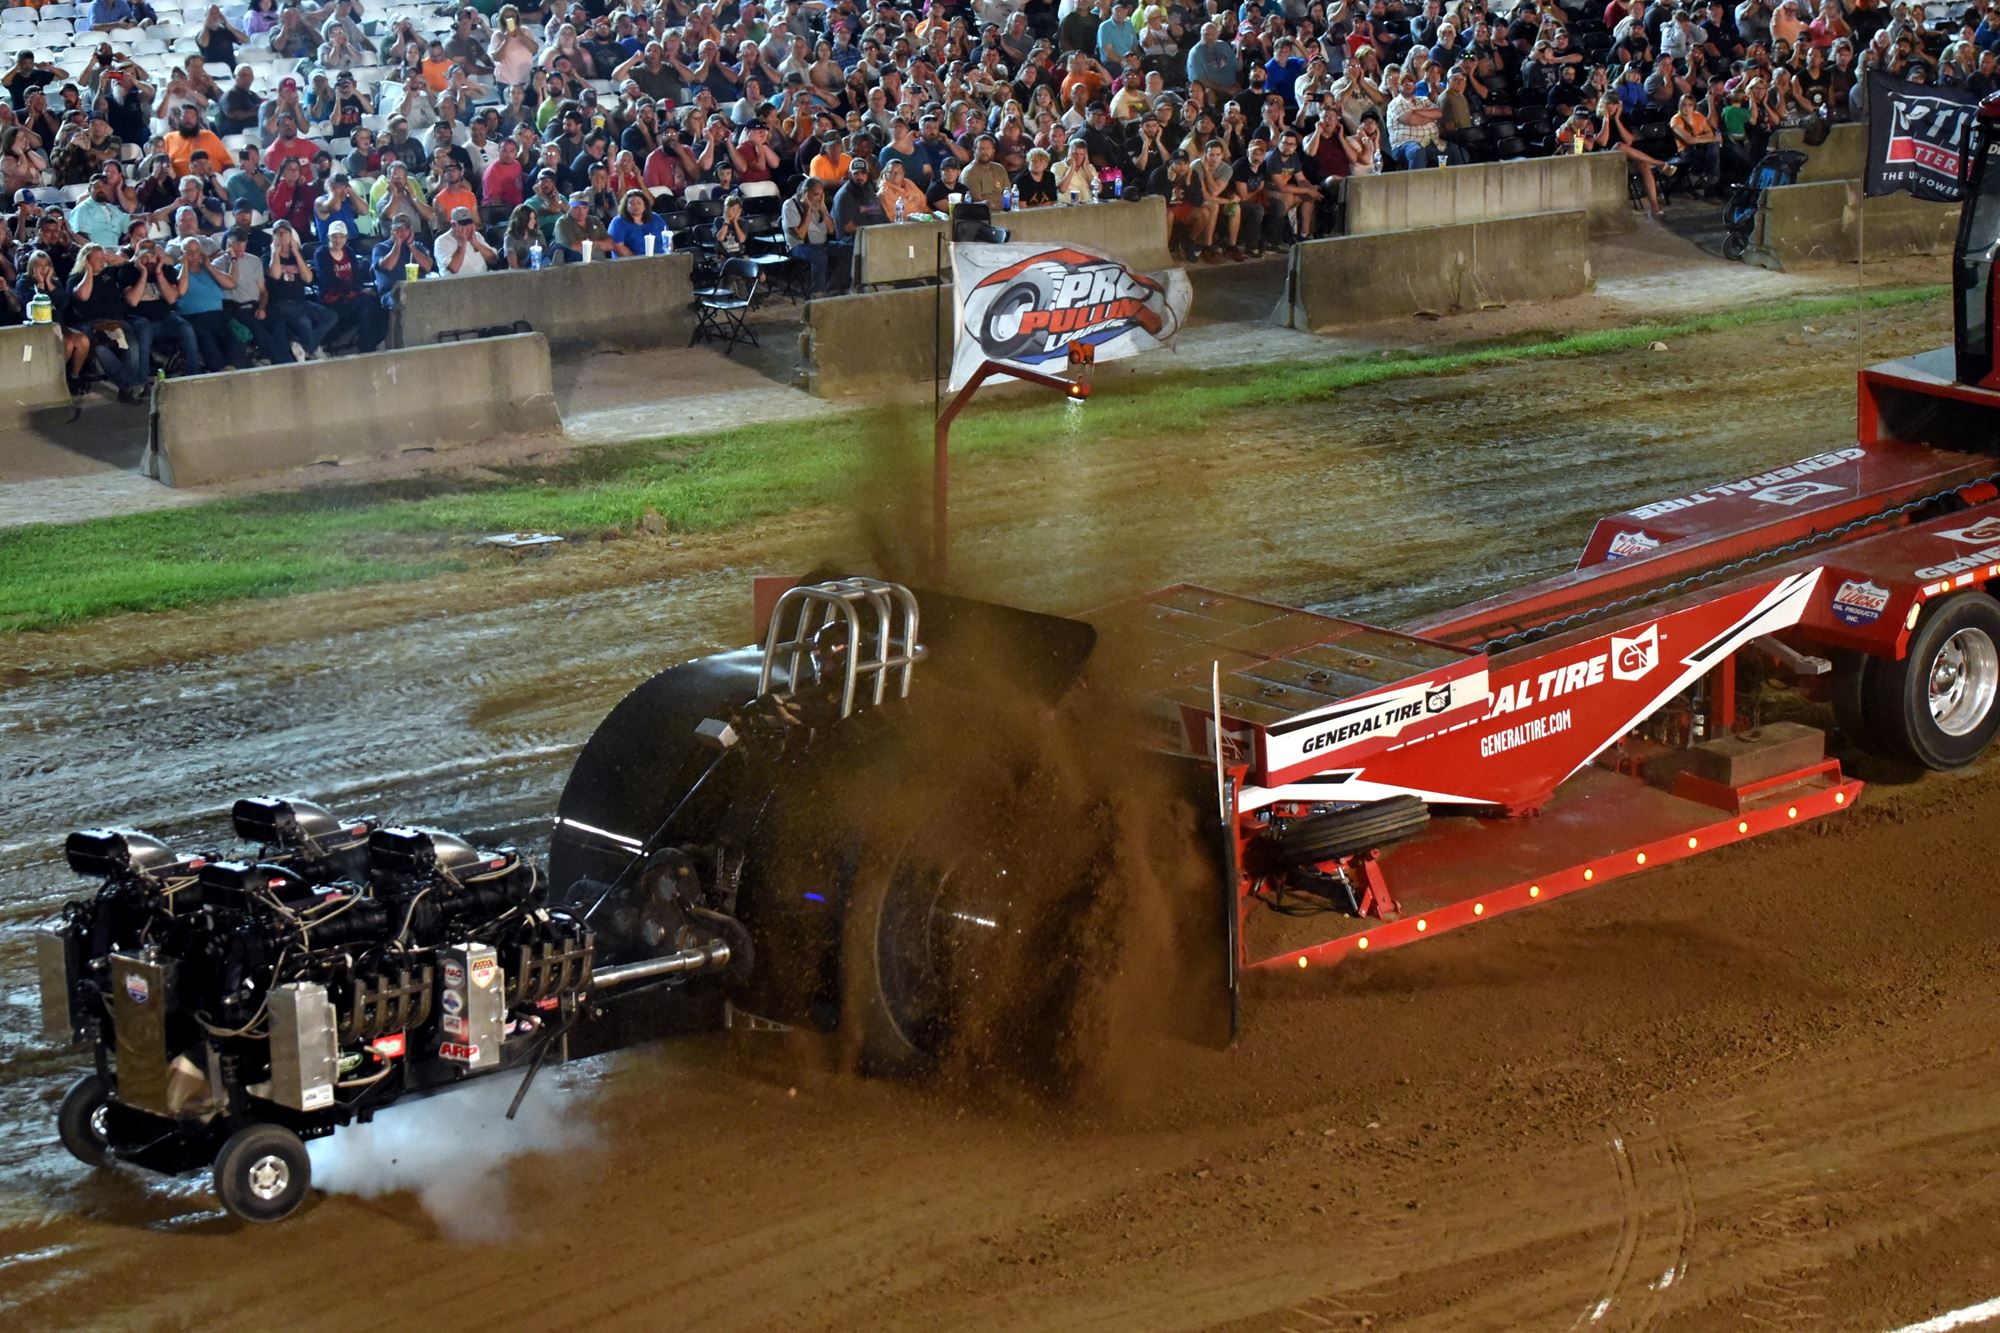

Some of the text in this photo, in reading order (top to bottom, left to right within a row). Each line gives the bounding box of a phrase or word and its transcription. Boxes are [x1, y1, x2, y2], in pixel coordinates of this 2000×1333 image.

[1882, 171, 1904, 180] THE
[1919, 176, 1960, 197] POWER
[1055, 266, 1144, 309] PRO
[1627, 448, 1867, 520] GENERAL TIRE
[1832, 603, 1879, 619] OIL PRODUCTS
[1838, 590, 1886, 609] LUCAS
[1537, 653, 1608, 703] TIRE
[1302, 699, 1424, 754] GENERAL TIRE
[1480, 708, 1571, 758] GENERALTIRE.COM
[440, 1042, 478, 1060] ARP
